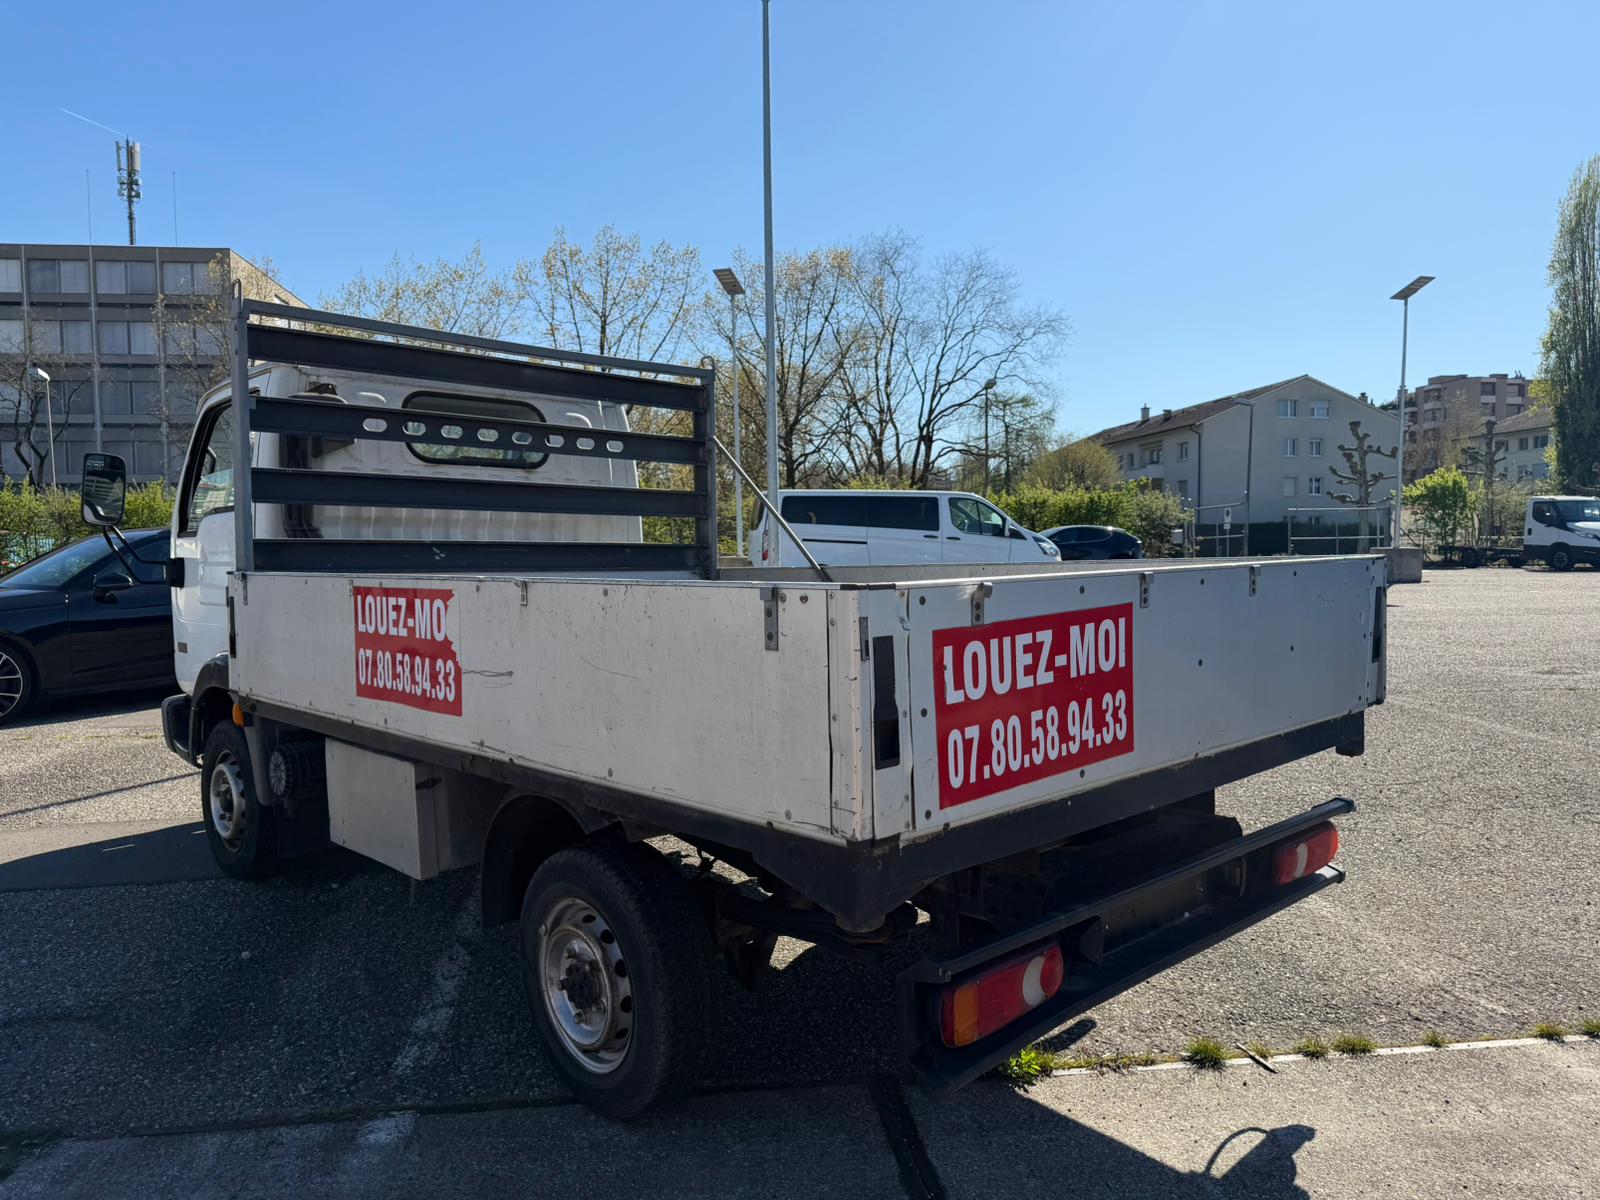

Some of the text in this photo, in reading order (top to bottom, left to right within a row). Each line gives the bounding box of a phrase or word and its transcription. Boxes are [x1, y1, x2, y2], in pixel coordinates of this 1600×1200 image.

[357, 595, 447, 642] LOUEZ-MO
[358, 647, 456, 702] 07.80.58.94.33
[943, 617, 1126, 705] LOUEZ-MOI
[947, 689, 1128, 789] 07.80.58.94.33
